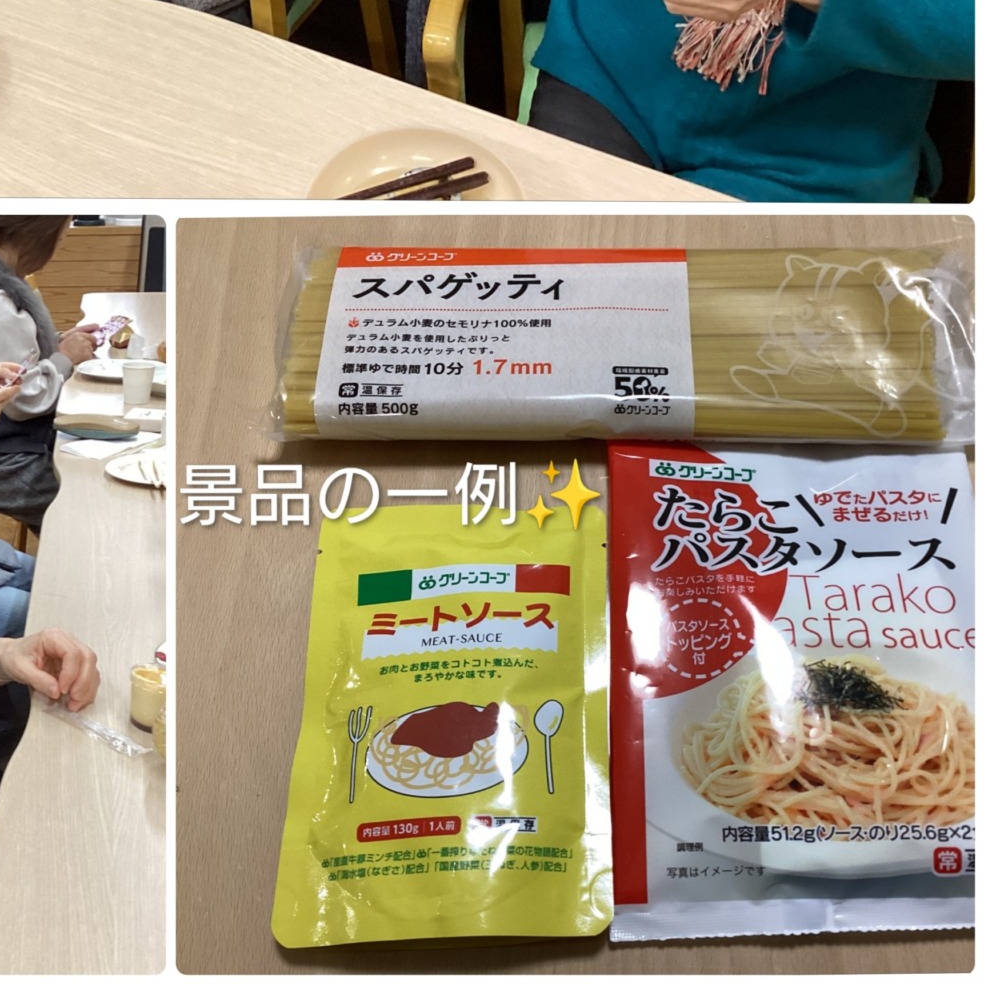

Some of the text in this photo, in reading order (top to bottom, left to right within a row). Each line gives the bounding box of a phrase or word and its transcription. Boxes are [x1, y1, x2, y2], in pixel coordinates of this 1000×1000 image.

[387, 252, 458, 262] グリーンコープ
[352, 271, 564, 300] スパゲッティ
[362, 318, 552, 329] デュラム小麦のセモリナ100%使用
[344, 345, 495, 356] 弾力のあるスパゲッティです。
[473, 359, 553, 375] 1.7mm
[614, 376, 670, 402] 50%
[626, 405, 671, 416] グリーンコープ
[678, 465, 757, 482] グリーンコープ
[813, 489, 942, 506] ゆでたパスタに
[655, 487, 799, 534] たらこ
[654, 532, 957, 574] パスタソース
[438, 571, 511, 588] グリーンコープ
[655, 574, 755, 585] たらこパスタを手軽に
[788, 573, 957, 614] Tarako
[366, 601, 555, 636] ミートソース
[666, 618, 730, 632] パスタソース
[774, 612, 872, 649] asta
[421, 632, 503, 648] MEAT-SAUCE
[666, 632, 733, 651] トッピング
[692, 652, 706, 665] 付
[379, 658, 540, 676] お肉とお野菜をコトコト煮込んだ、
[413, 669, 503, 683] まろやかな味です。
[429, 820, 456, 832] 1人前
[676, 842, 704, 852] 調理例
[666, 866, 767, 878] 写真はイメージです
